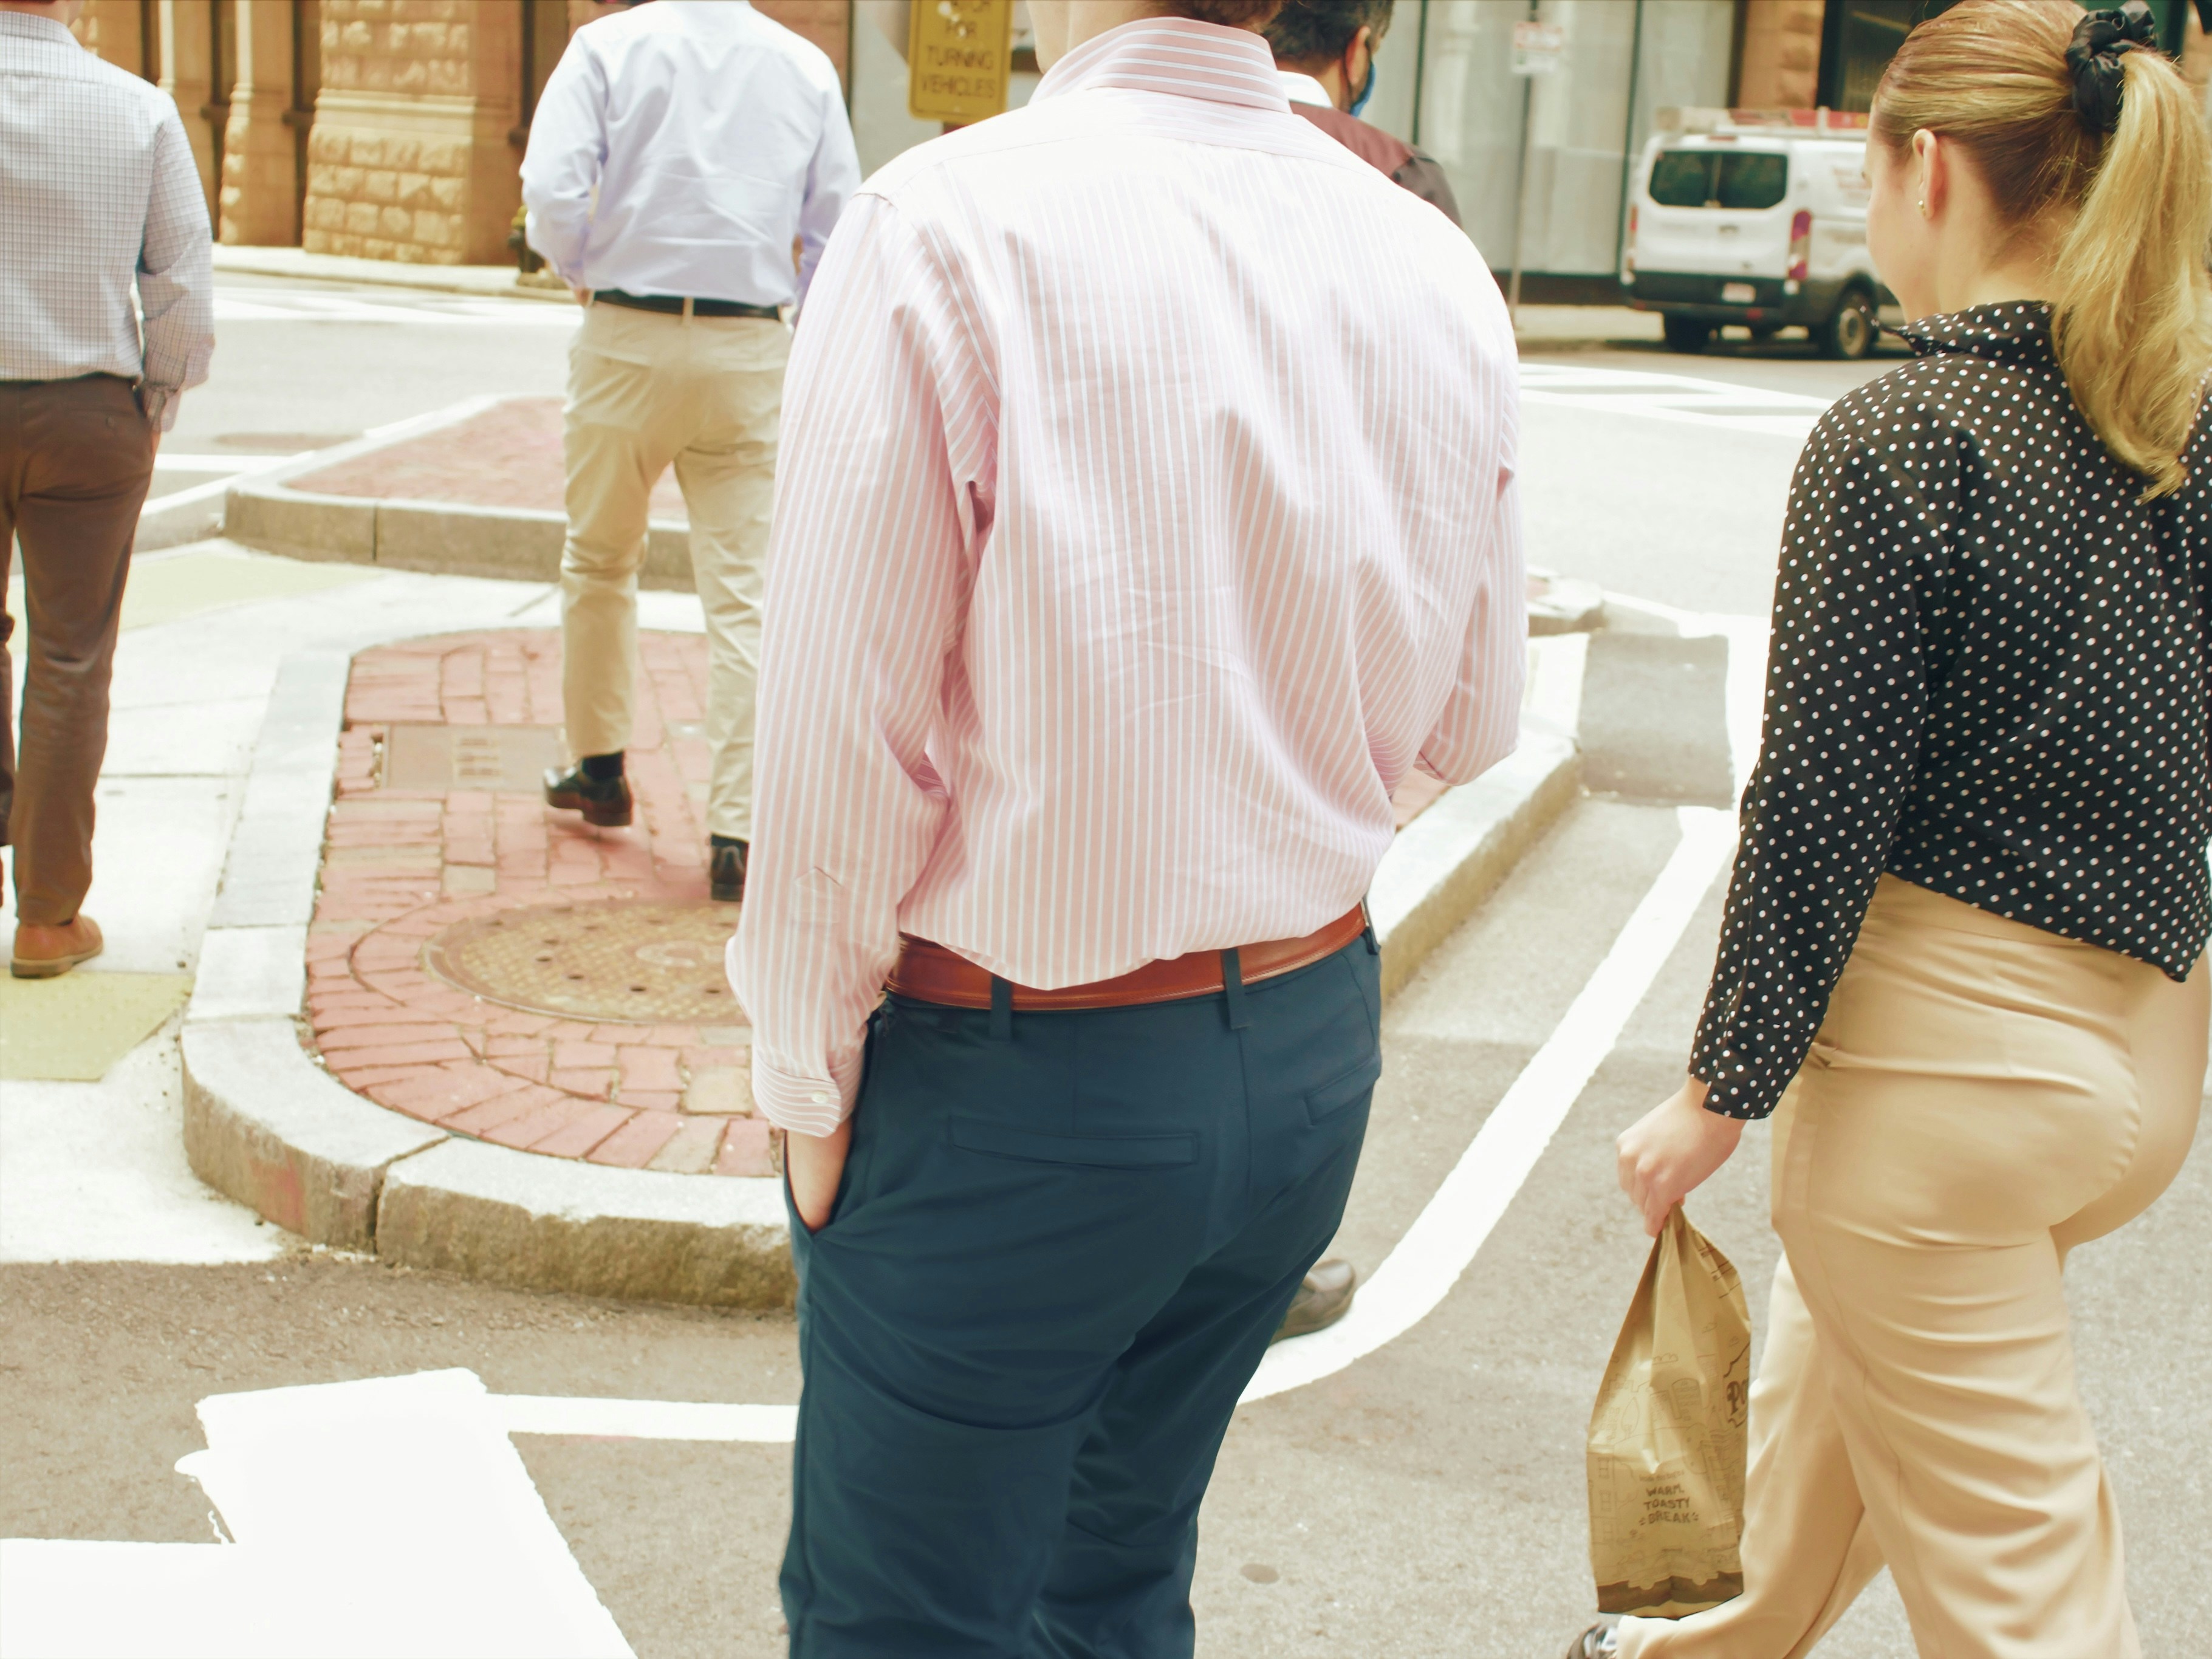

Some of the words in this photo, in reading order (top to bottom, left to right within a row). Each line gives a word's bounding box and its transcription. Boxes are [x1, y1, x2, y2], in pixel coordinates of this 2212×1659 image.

[927, 45, 994, 70] TURNING
[921, 74, 996, 98] VEHICLES
[1643, 1497, 1690, 1511] TOASTY
[1648, 1510, 1691, 1524] BREAK
